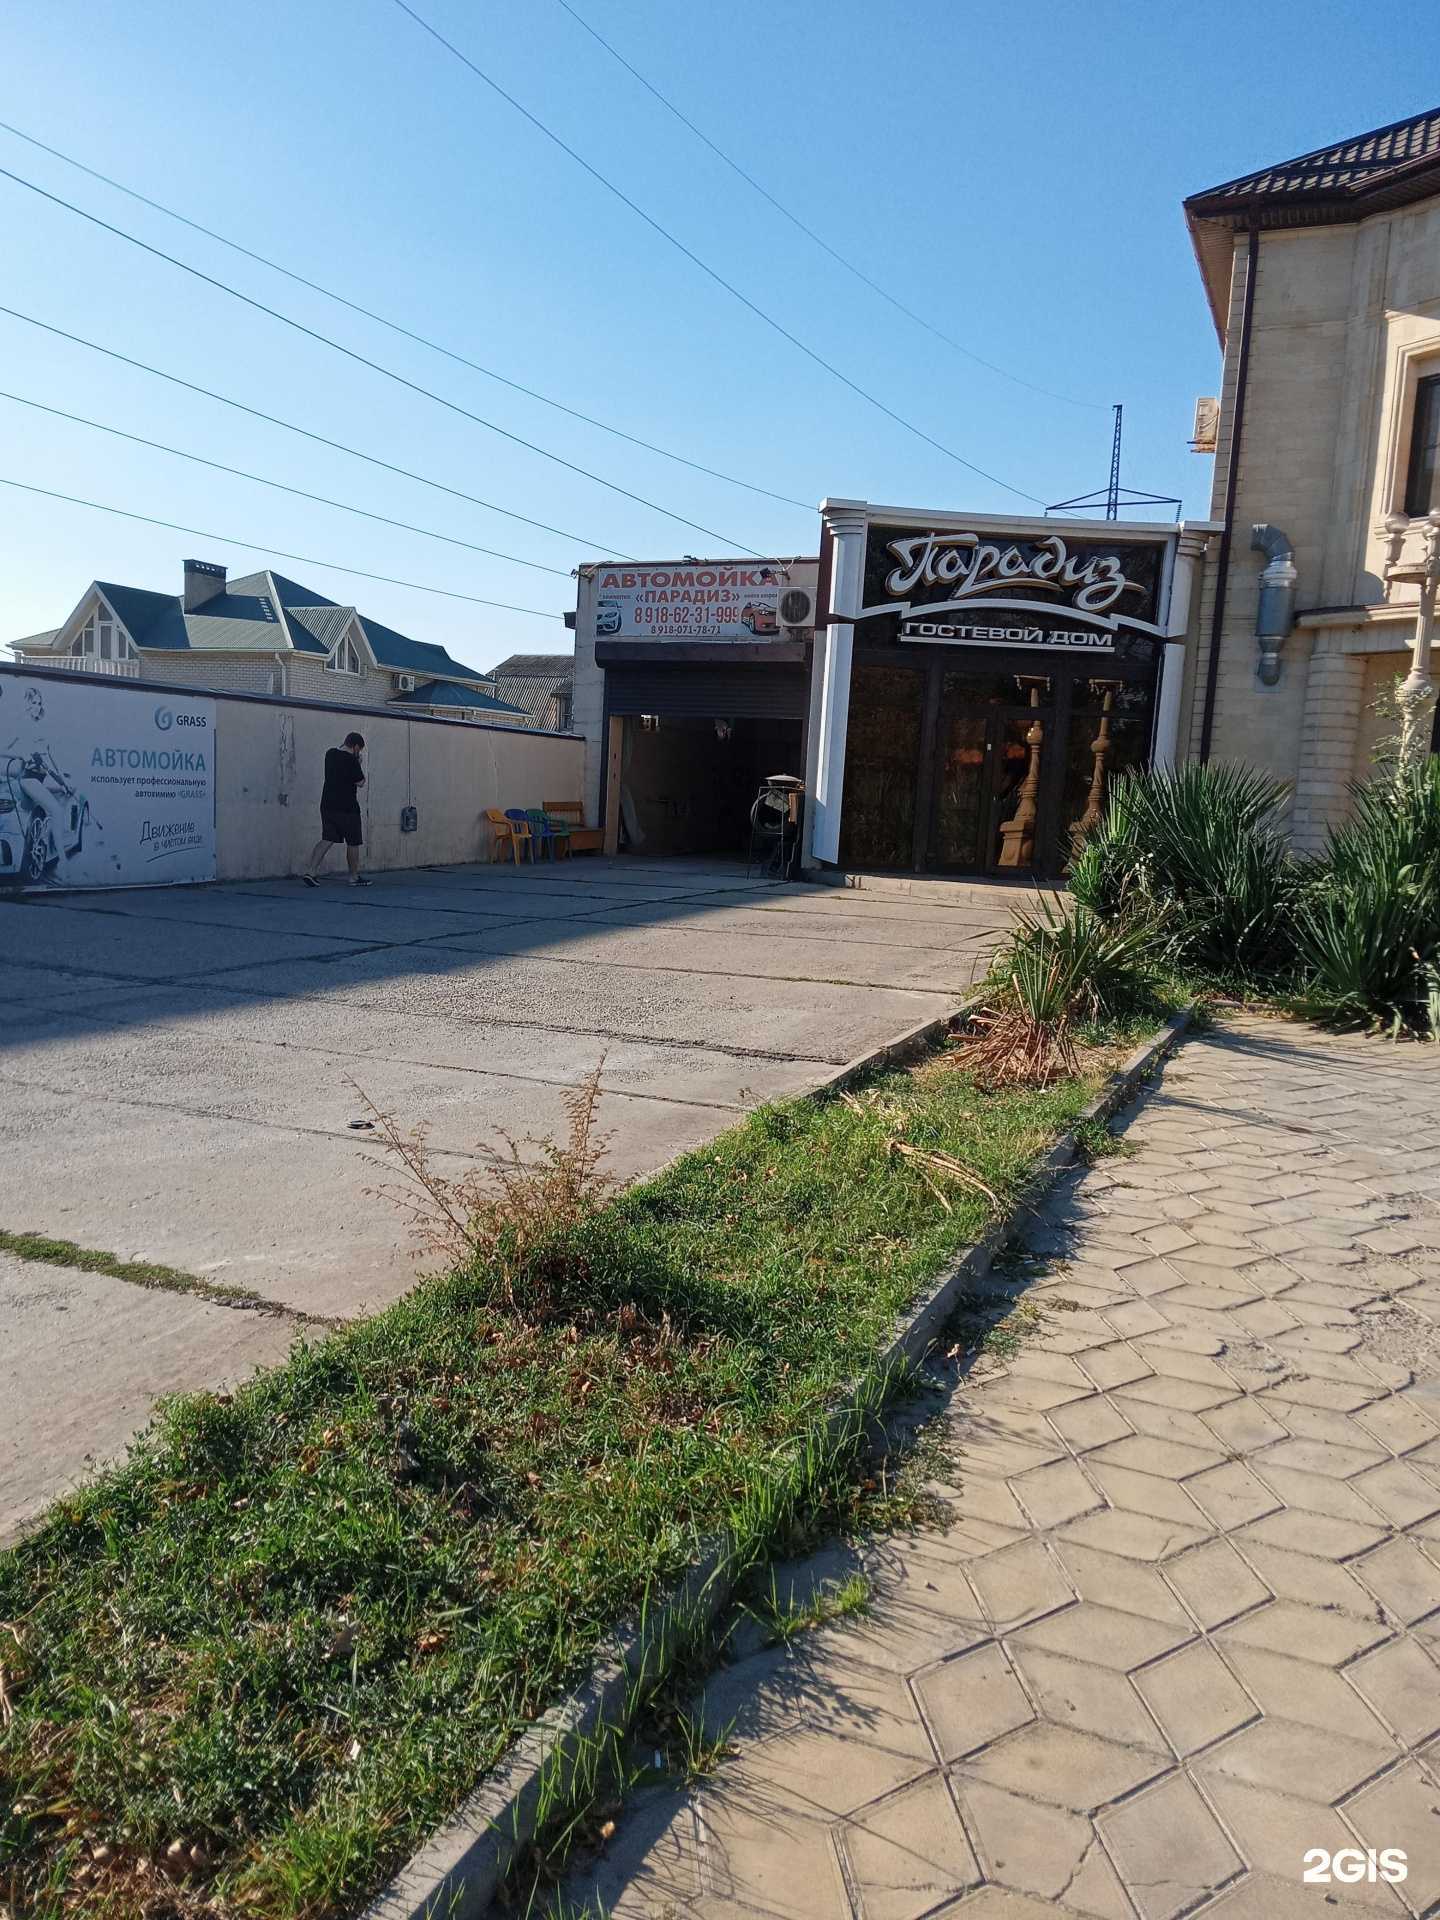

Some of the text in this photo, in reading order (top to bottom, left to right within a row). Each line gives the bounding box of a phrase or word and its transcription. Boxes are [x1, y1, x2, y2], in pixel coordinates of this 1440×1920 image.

[601, 566, 780, 588] АВТОМОЙКА
[886, 532, 1144, 613] Парадиз
[636, 589, 740, 605] «ПАРАДИЗ»
[634, 607, 643, 624] 8
[904, 621, 1113, 647] ГОСТЕВОЙ ДОМ
[176, 714, 207, 728] GRASS
[91, 747, 206, 771] АВТОМОЙКА
[91, 775, 207, 788] использует профессиональную
